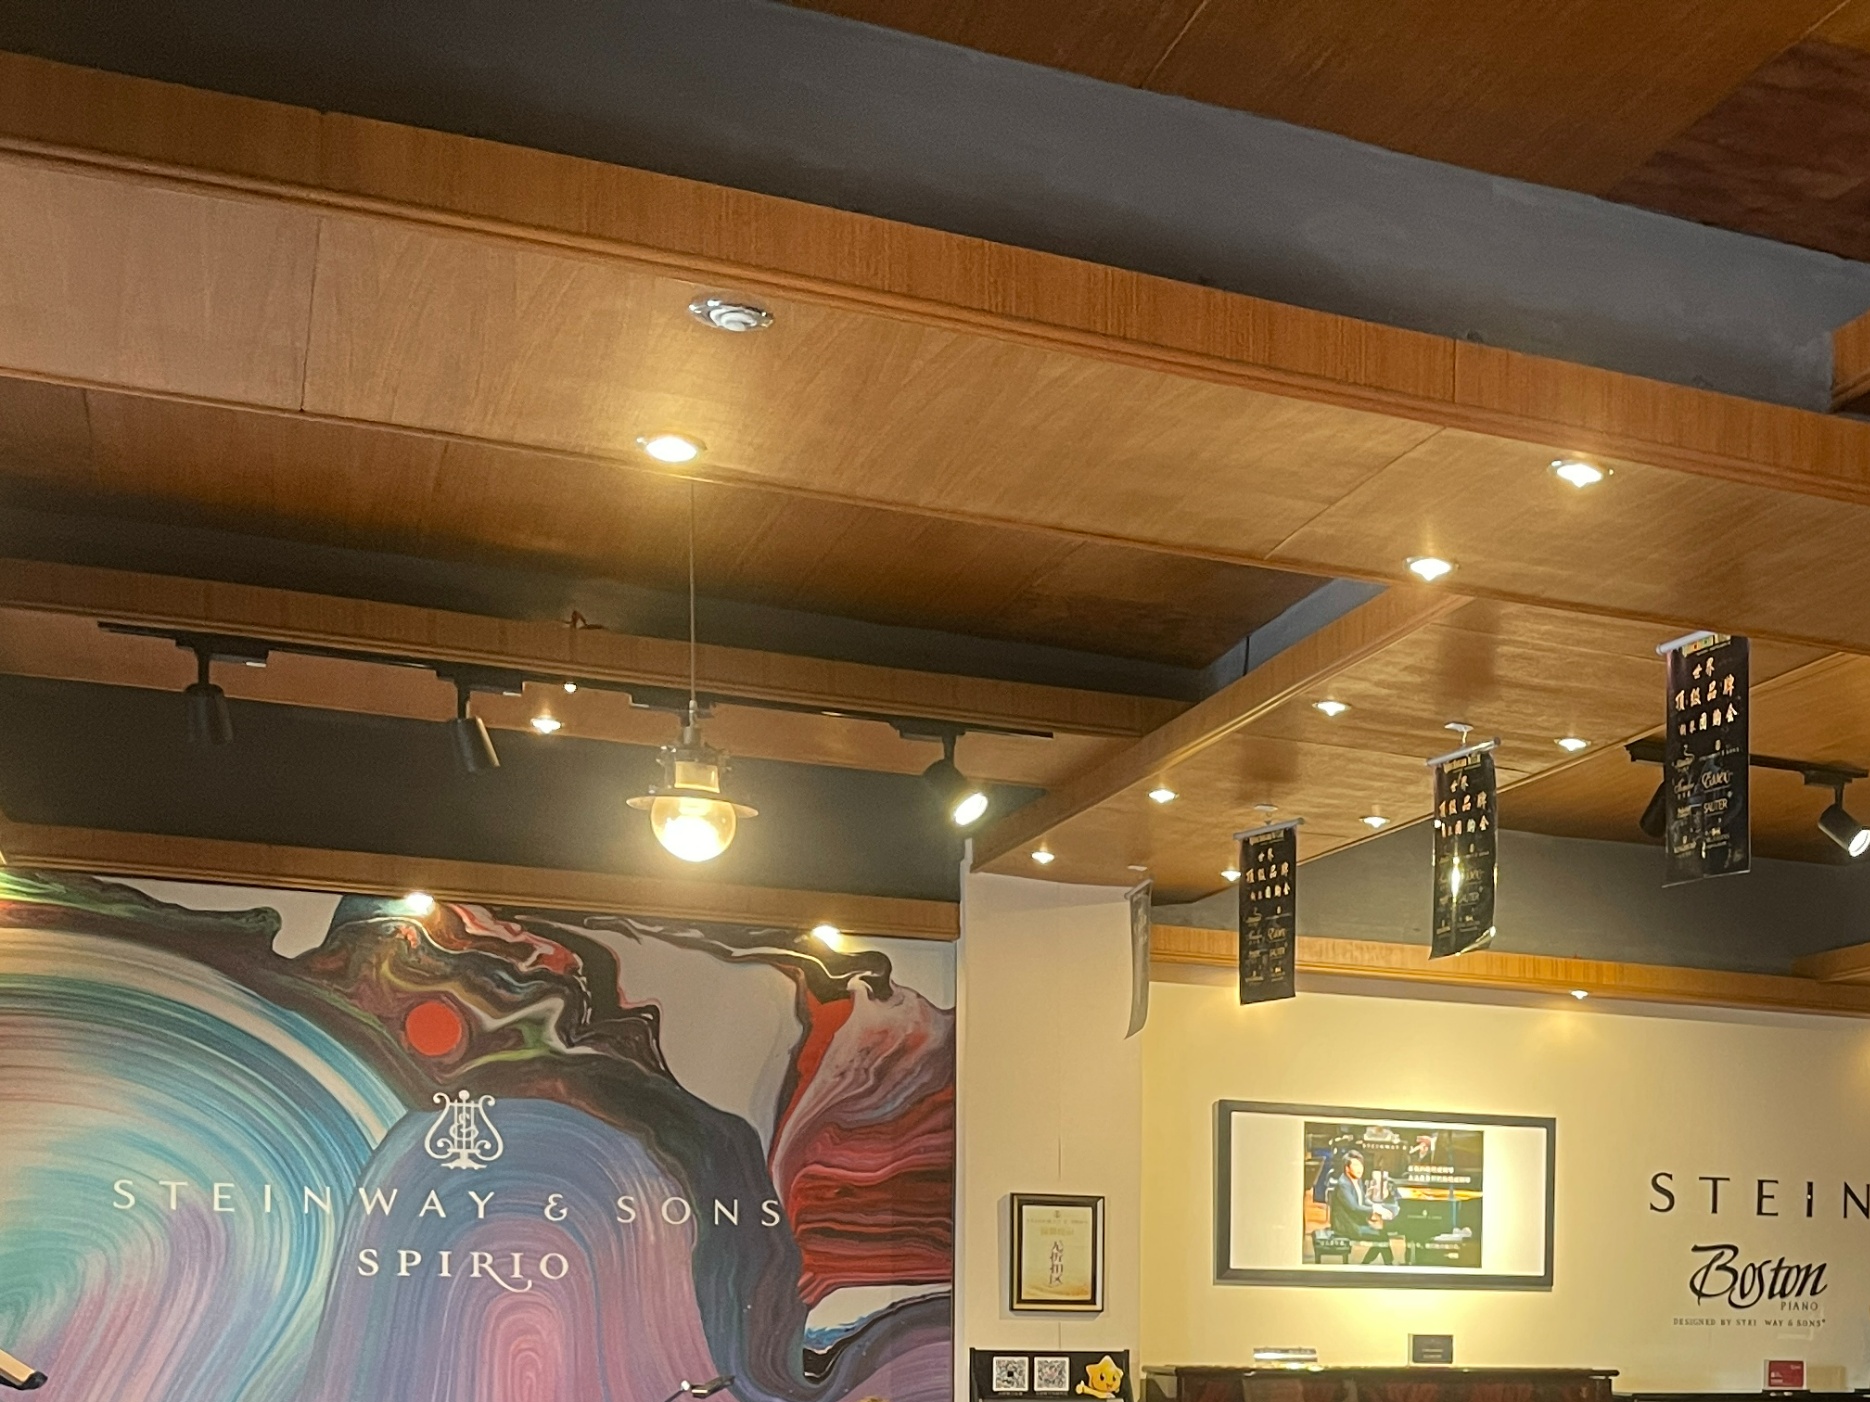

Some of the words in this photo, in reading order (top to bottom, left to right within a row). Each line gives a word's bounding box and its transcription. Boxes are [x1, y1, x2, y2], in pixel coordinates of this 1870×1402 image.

[112, 1179, 497, 1220] STEINWAY
[544, 1192, 569, 1222] &
[615, 1194, 782, 1228] SONS
[357, 1248, 570, 1294] SPIRIO
[1688, 1243, 1828, 1310] Boston
[1673, 1317, 1717, 1326] DESIGNED
[1720, 1318, 1732, 1327] BY
[1780, 1301, 1820, 1312] PIANO
